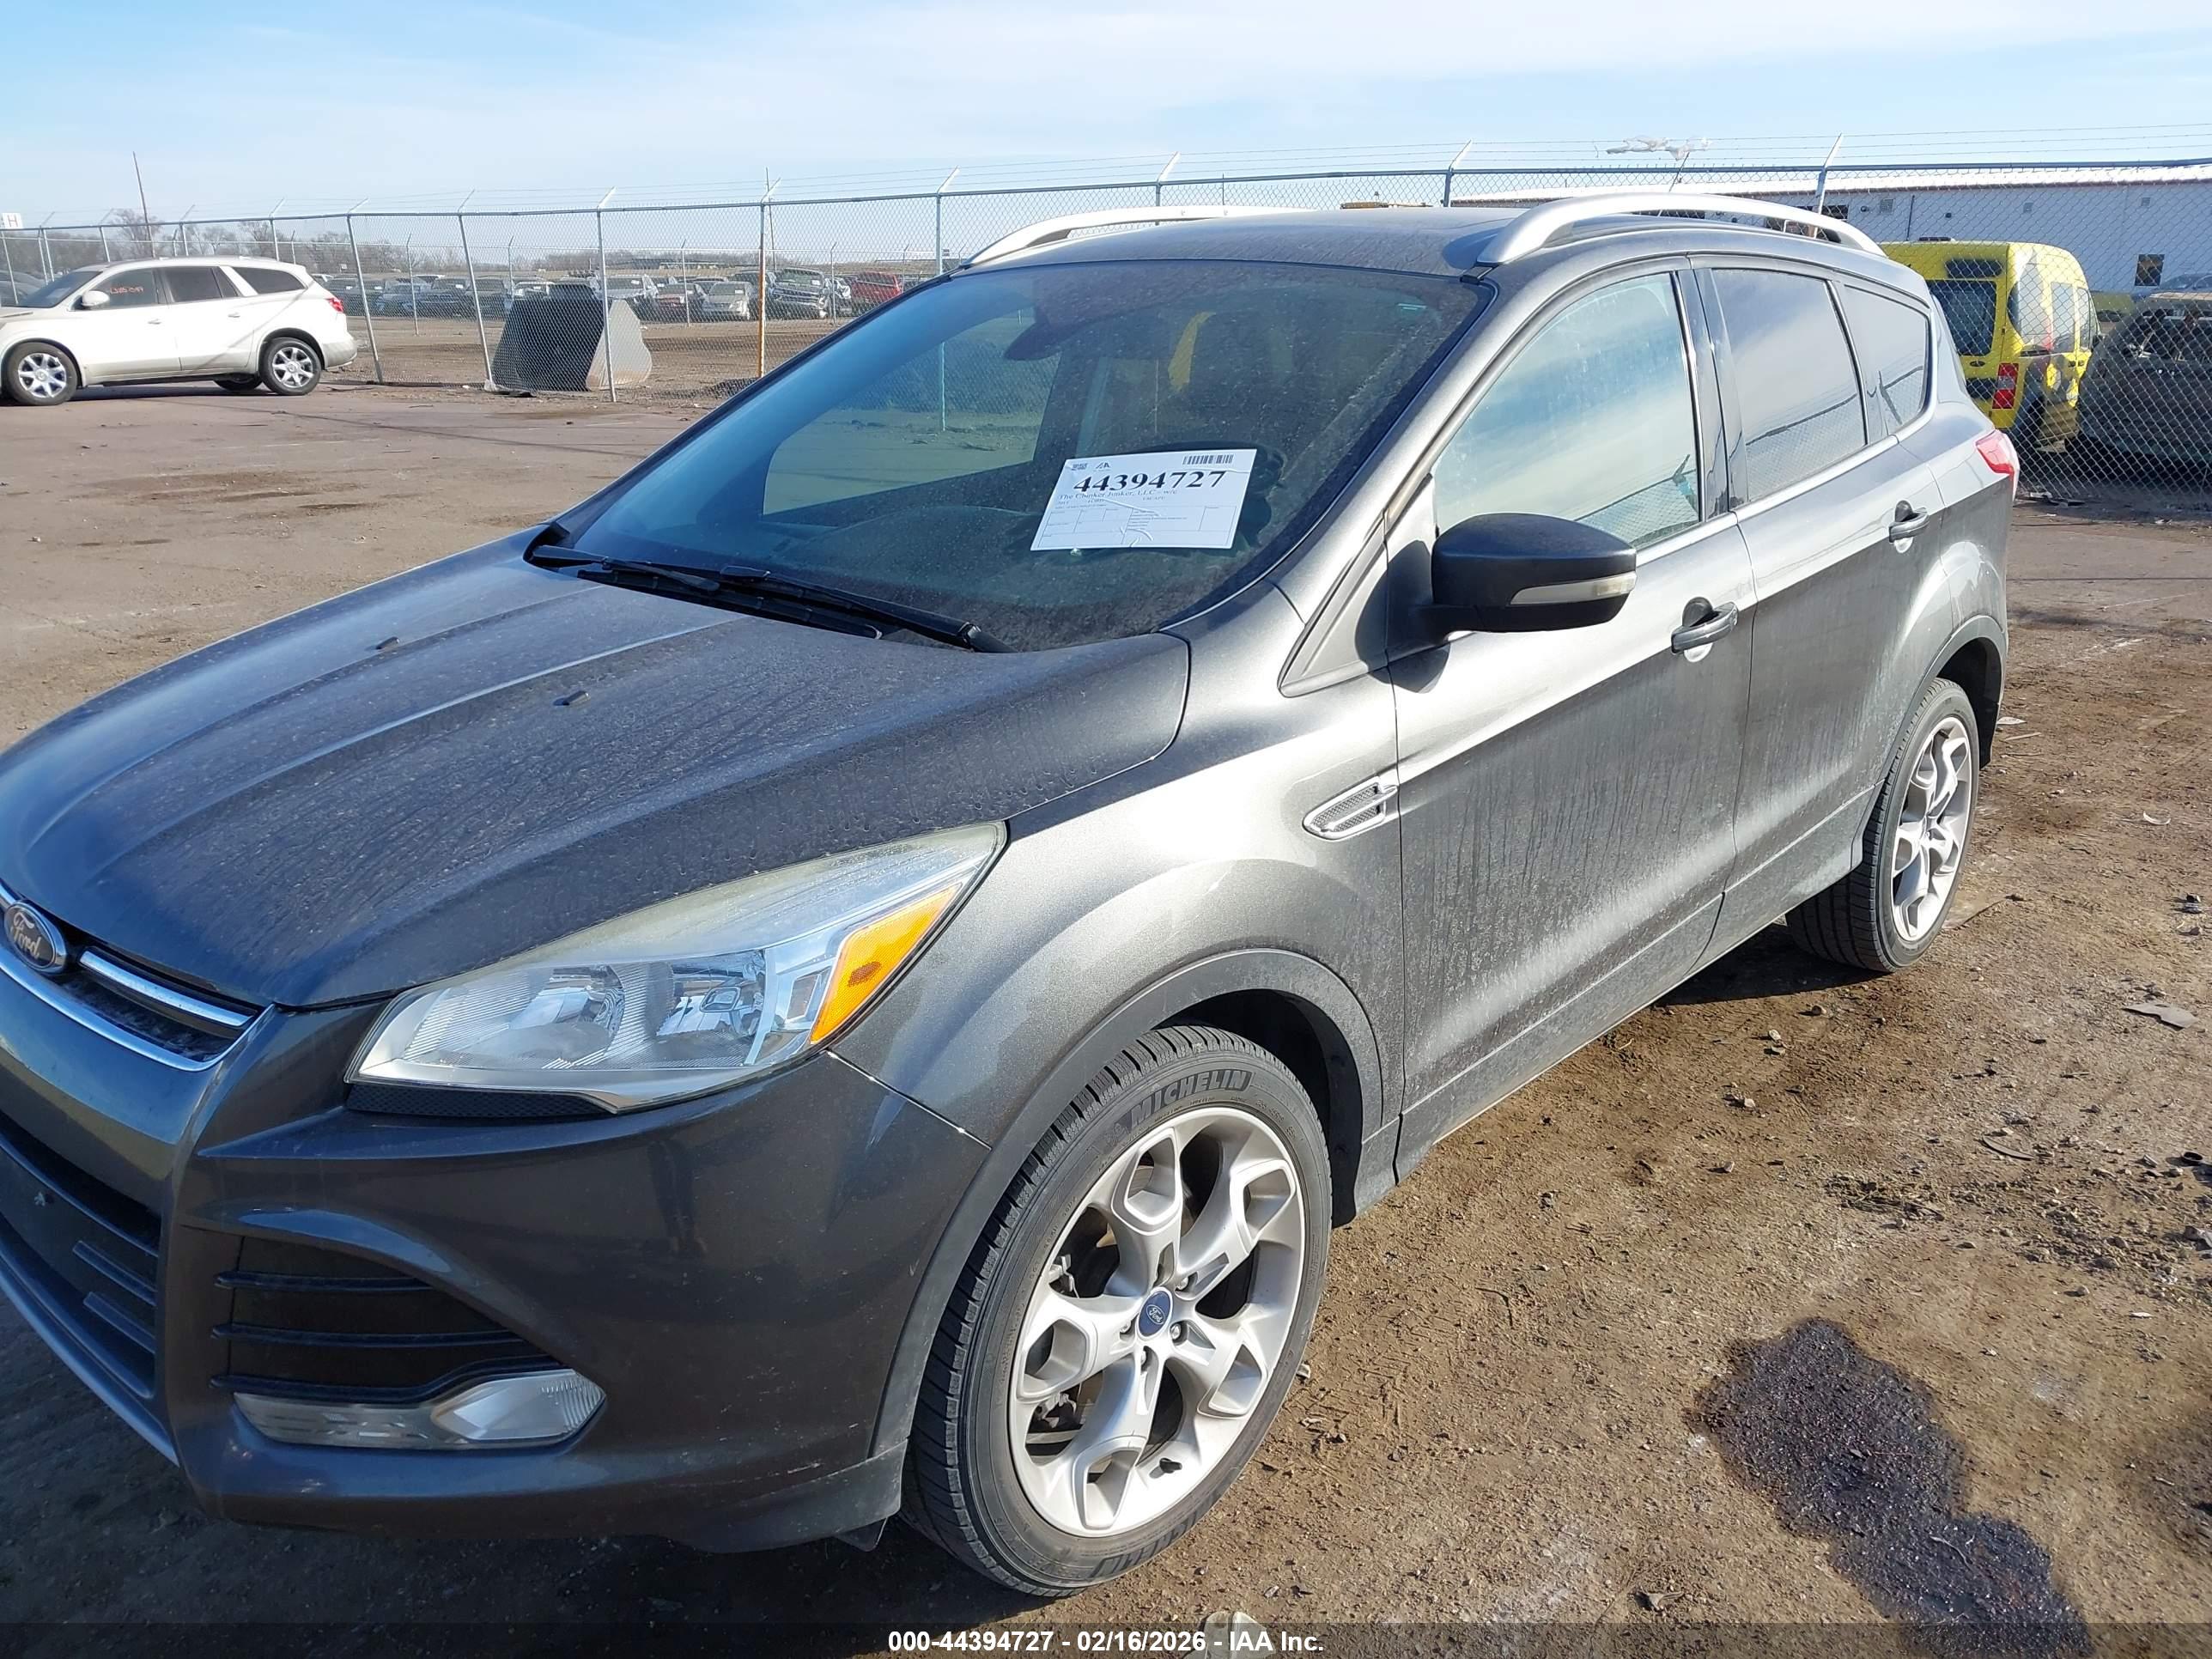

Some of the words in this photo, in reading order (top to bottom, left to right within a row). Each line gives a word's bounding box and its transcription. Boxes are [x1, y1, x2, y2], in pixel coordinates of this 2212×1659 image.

[7, 214, 19, 228] H
[1073, 471, 1226, 492] 44394727
[10, 911, 42, 959] Ford
[1130, 1070, 1247, 1127] MICHELIN
[1149, 1307, 1164, 1323] Ford
